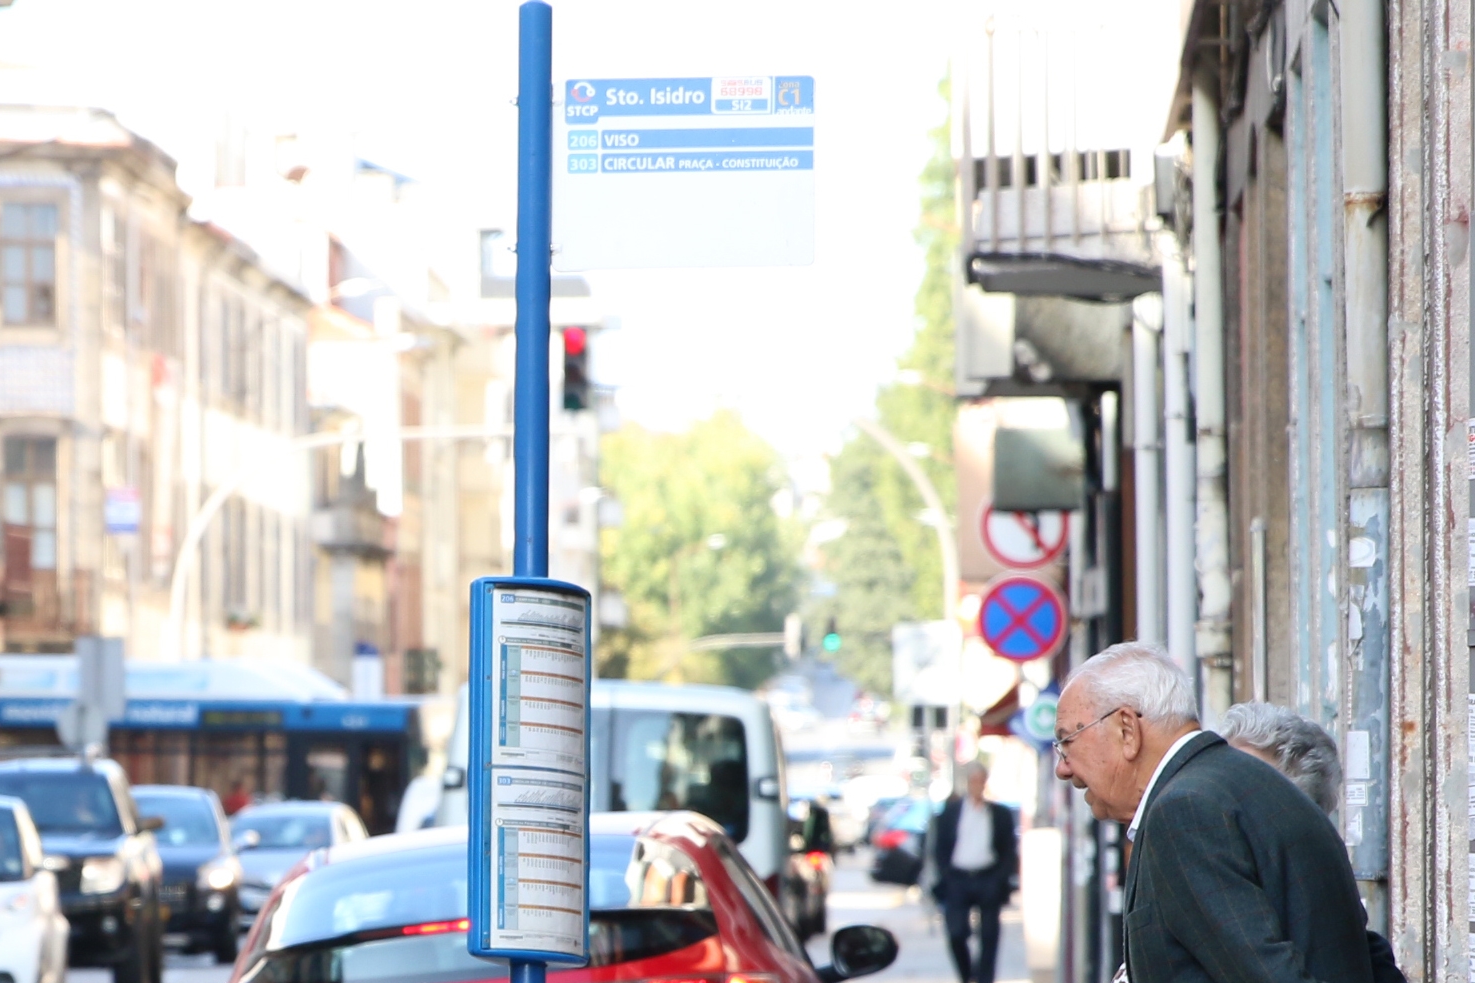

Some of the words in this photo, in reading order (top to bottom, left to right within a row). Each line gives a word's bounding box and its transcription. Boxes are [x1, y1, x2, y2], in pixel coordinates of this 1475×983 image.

[605, 87, 644, 106] Sto.
[650, 85, 705, 105] Isidro
[720, 86, 763, 97] 68998
[777, 89, 801, 106] C1
[566, 105, 599, 117] STCP
[569, 134, 597, 148] 206
[604, 133, 639, 147] VISO
[569, 158, 597, 171] 303
[603, 157, 675, 171] CIRCULAR
[678, 159, 713, 171] PRAÇA
[722, 156, 799, 170] CONSTITUIÇÃO
